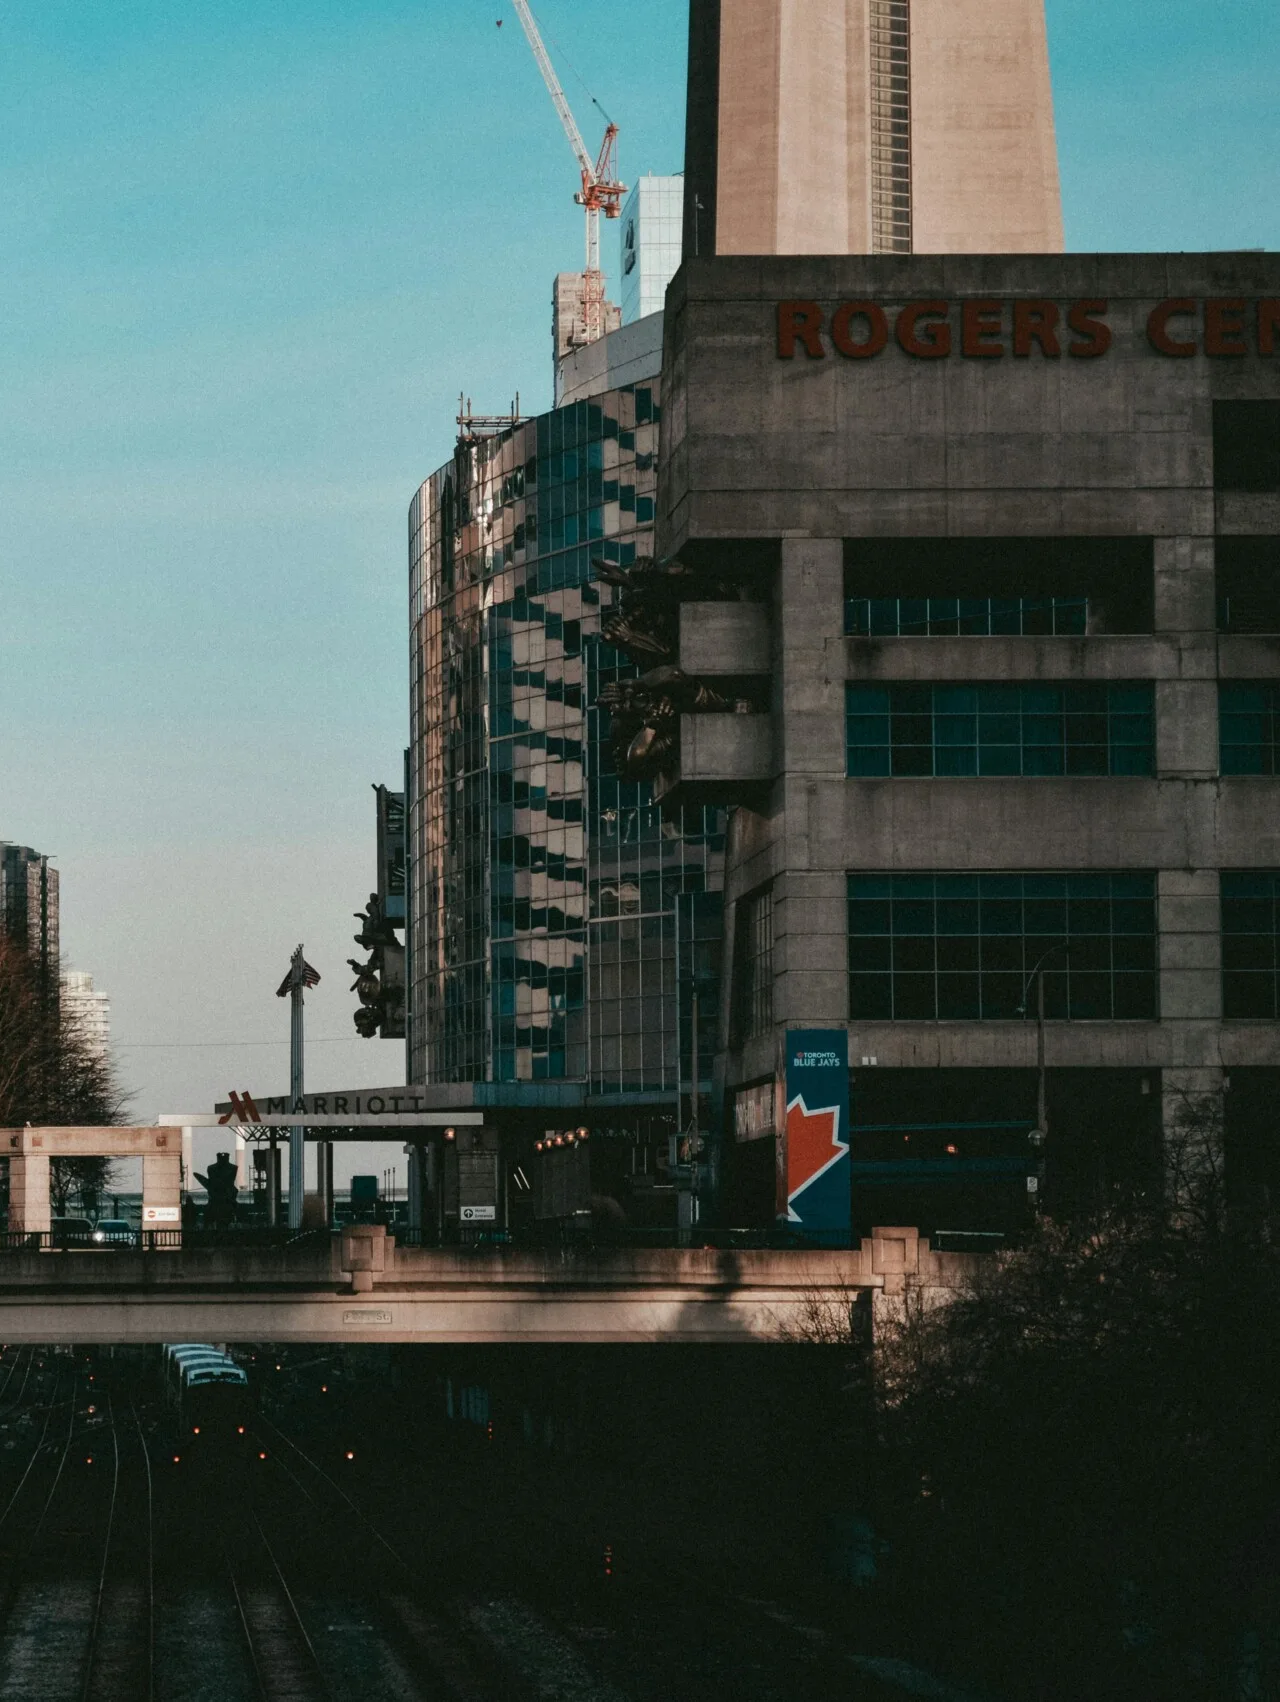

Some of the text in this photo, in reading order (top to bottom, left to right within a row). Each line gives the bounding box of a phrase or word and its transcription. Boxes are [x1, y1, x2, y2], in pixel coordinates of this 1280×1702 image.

[776, 298, 1112, 358] ROGERS
[793, 1058, 840, 1067] BLUE JAYS
[267, 1096, 425, 1115] MARRIOTT
